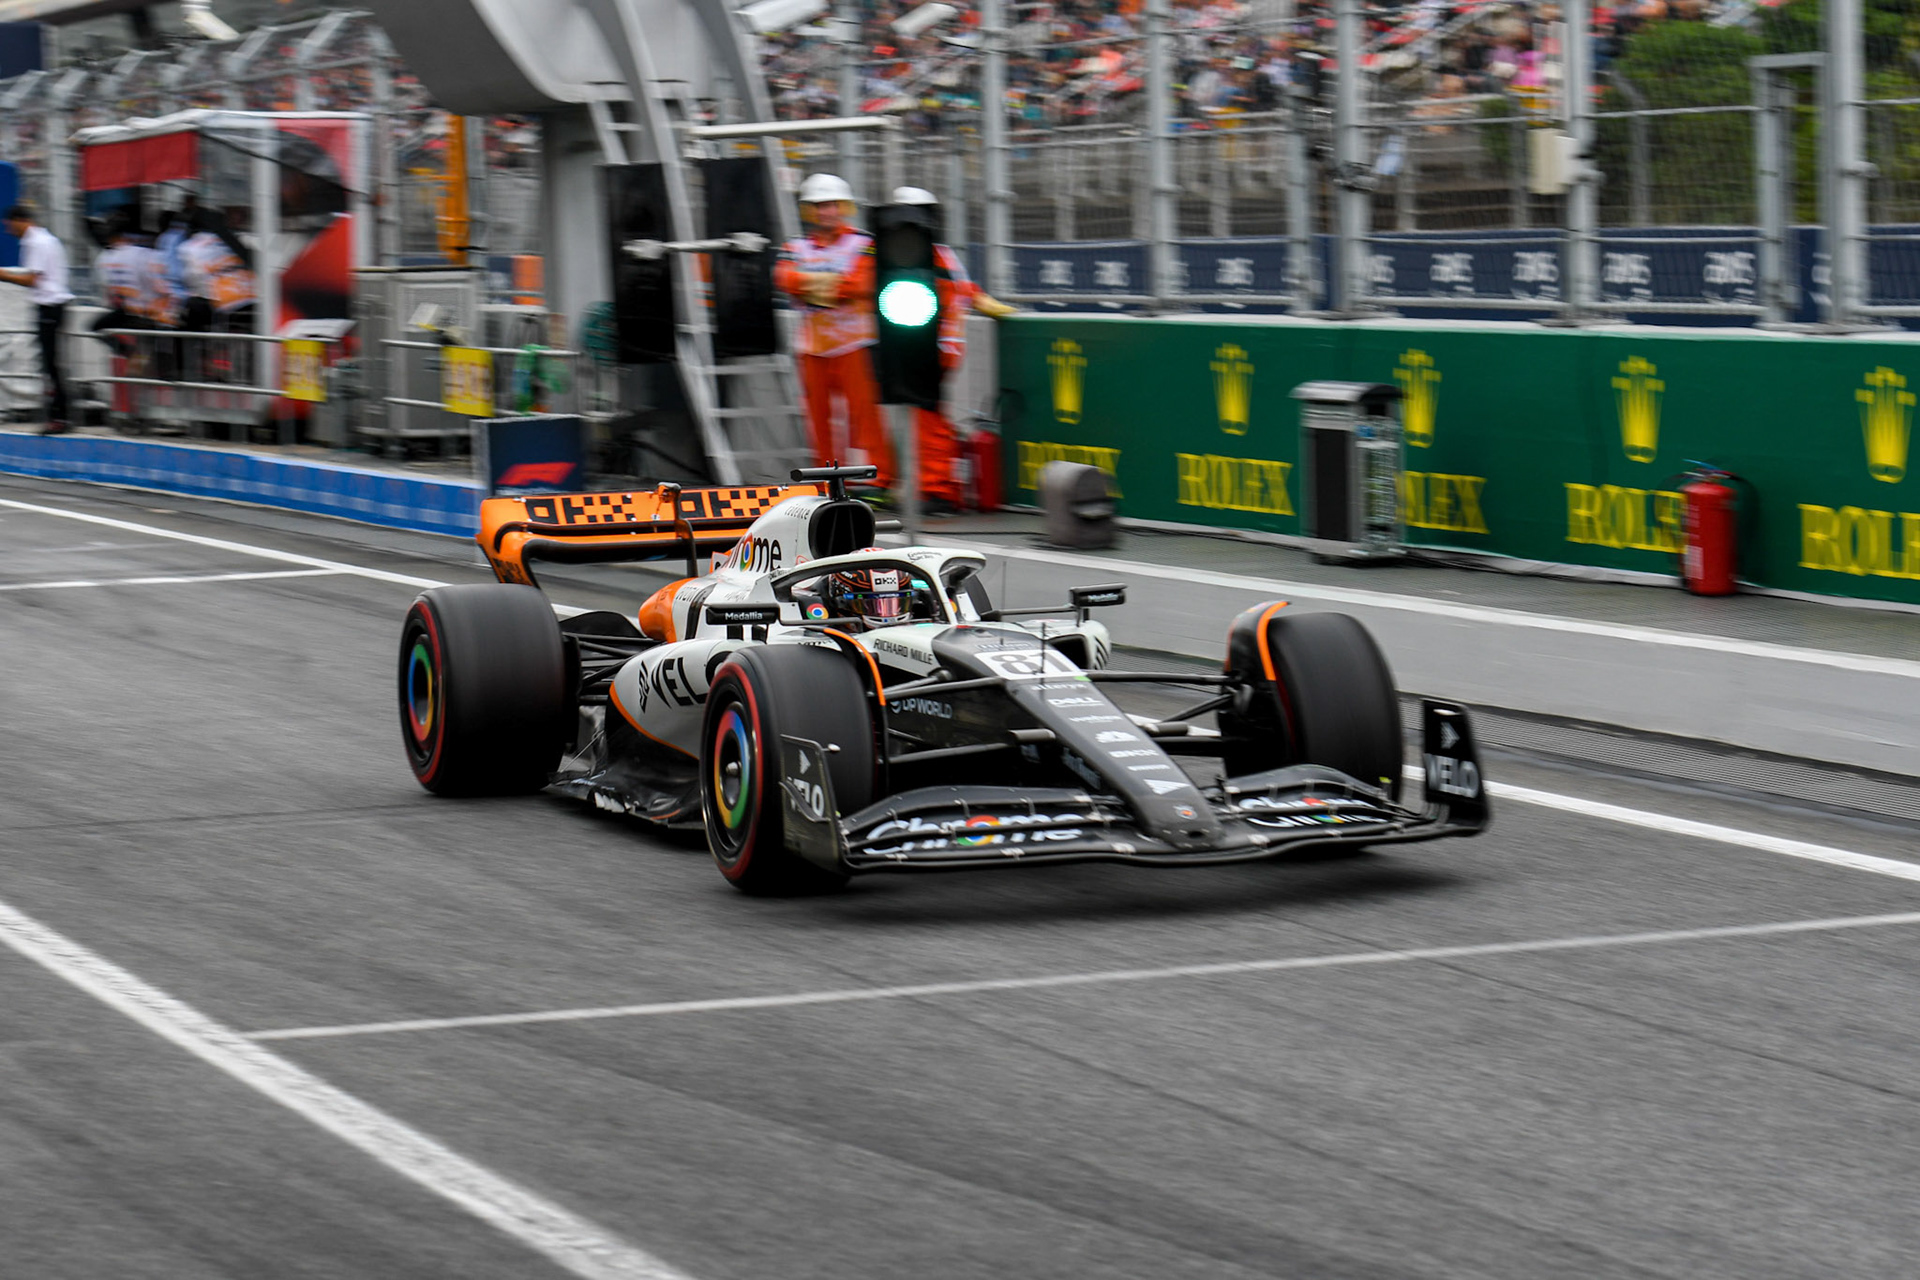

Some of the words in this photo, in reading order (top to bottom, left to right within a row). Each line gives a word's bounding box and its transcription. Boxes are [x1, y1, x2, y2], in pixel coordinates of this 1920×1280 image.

[1175, 452, 1296, 516] ROLEX
[524, 497, 636, 524] OKX
[1563, 482, 1688, 554] ROLE
[1797, 503, 1920, 580] ROLE
[725, 610, 763, 621] Medallia
[873, 638, 908, 658] RICHARD
[910, 648, 933, 665] MILLE
[991, 653, 1073, 675] 81
[902, 699, 916, 712] DP
[916, 700, 953, 719] WORLD
